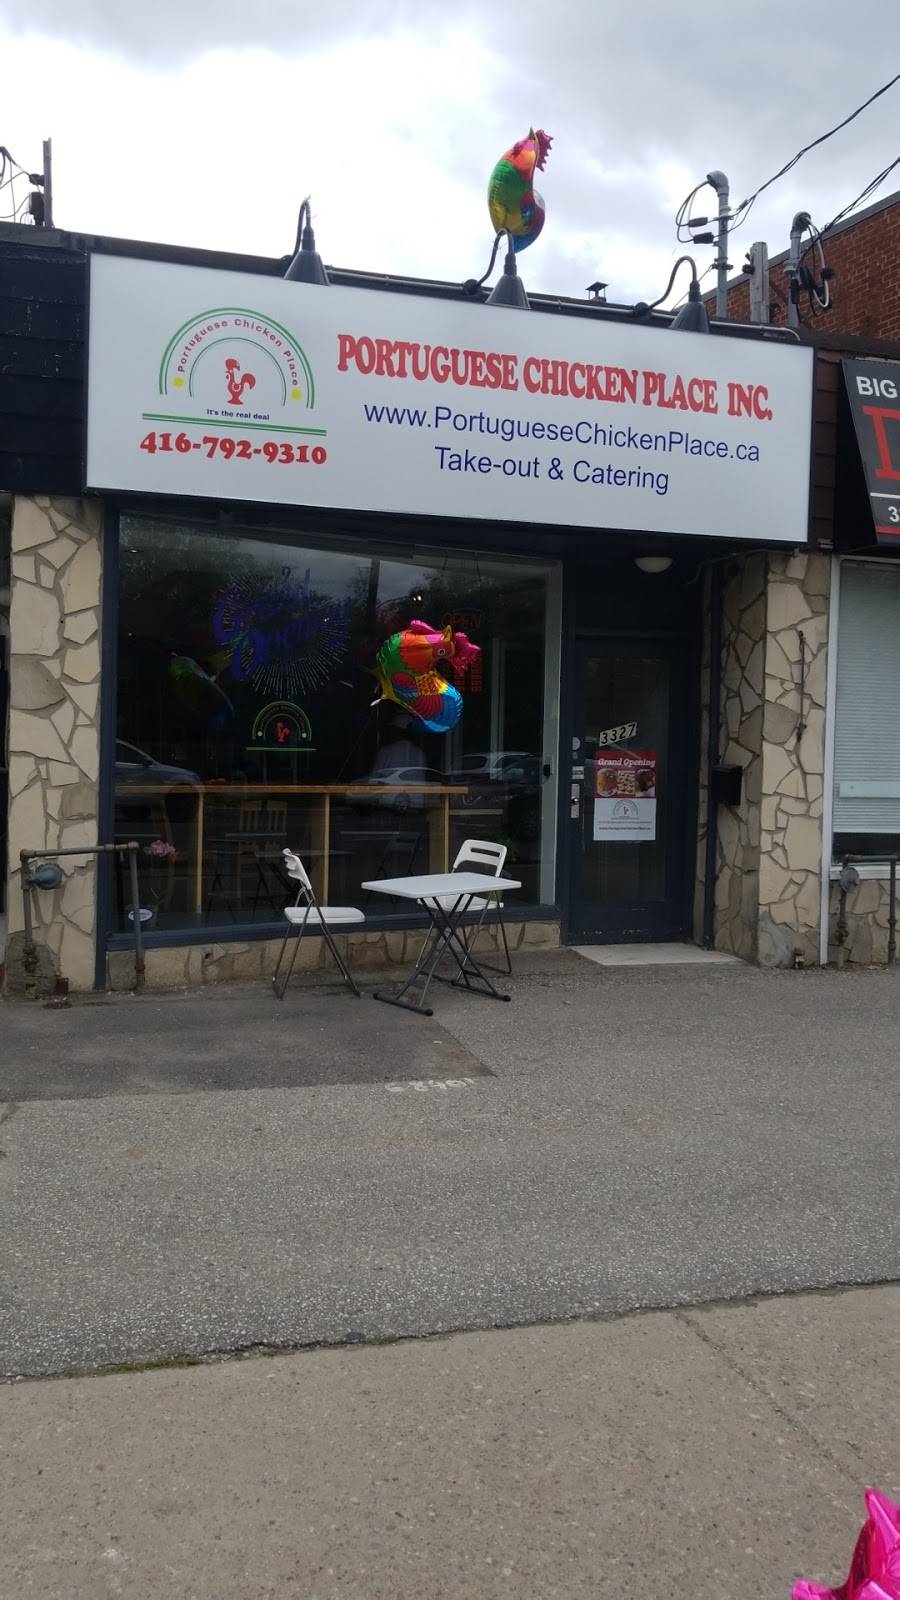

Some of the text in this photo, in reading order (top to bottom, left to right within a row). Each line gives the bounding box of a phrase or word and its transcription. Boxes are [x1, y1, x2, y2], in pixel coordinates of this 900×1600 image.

[177, 318, 298, 386] Portuguese Chicken Place
[337, 334, 519, 391] PORTUGUESE
[522, 357, 638, 404] CHICKEN
[642, 371, 719, 415] PLACE
[856, 376, 898, 399] BIG
[221, 409, 234, 417] the
[236, 411, 251, 419] real
[253, 412, 270, 421] deal
[139, 431, 327, 465] 416-792-9310
[364, 404, 760, 462] www.PortugueseChickenPlace.ca
[435, 445, 669, 496] Take-out & Catering
[601, 723, 637, 745] 3327
[598, 758, 656, 767] Grand Opening
